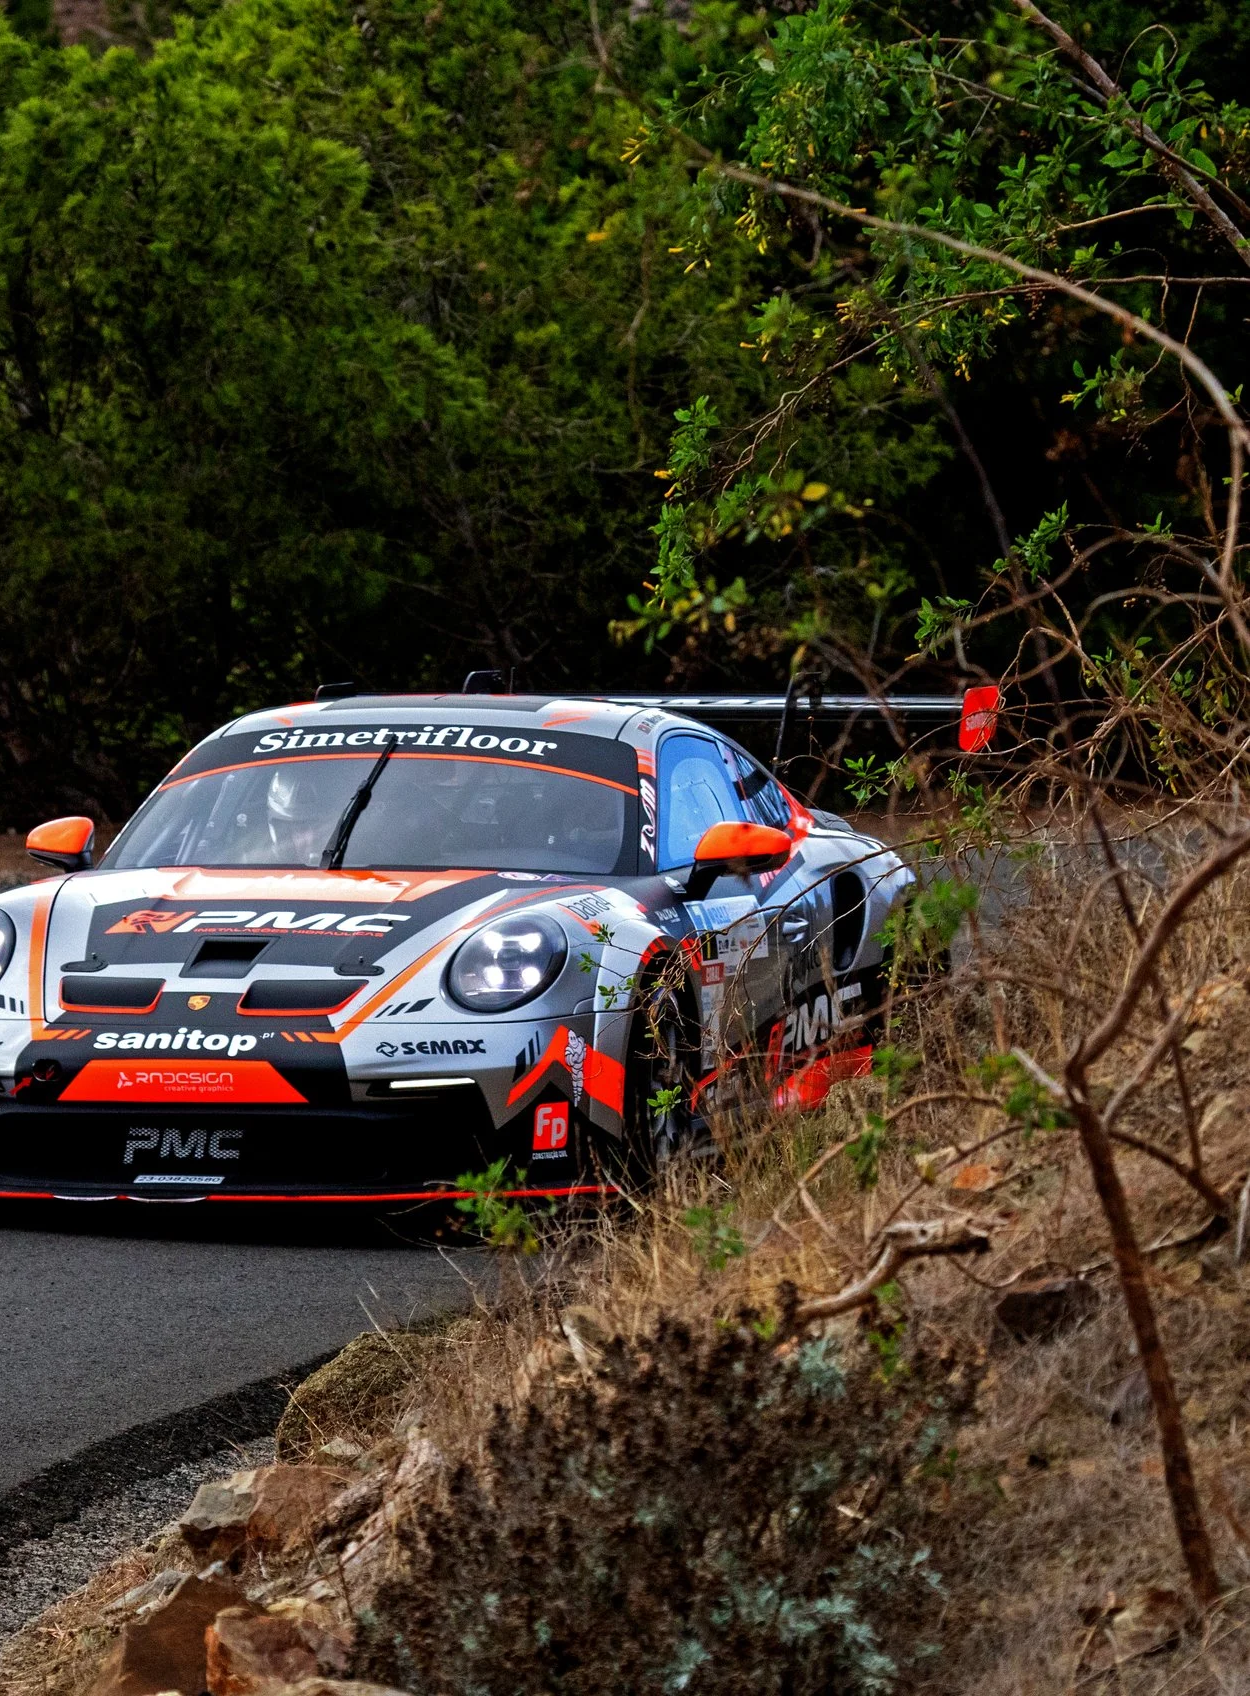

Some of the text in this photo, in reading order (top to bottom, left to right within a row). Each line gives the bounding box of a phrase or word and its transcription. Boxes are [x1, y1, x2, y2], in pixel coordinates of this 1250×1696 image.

[253, 726, 557, 756] Simetrifloor
[172, 911, 412, 933] PMC
[93, 1027, 257, 1057] sanitop
[401, 1039, 487, 1055] SEMAX
[199, 1085, 234, 1093] graphics
[124, 1127, 243, 1164] PMC
